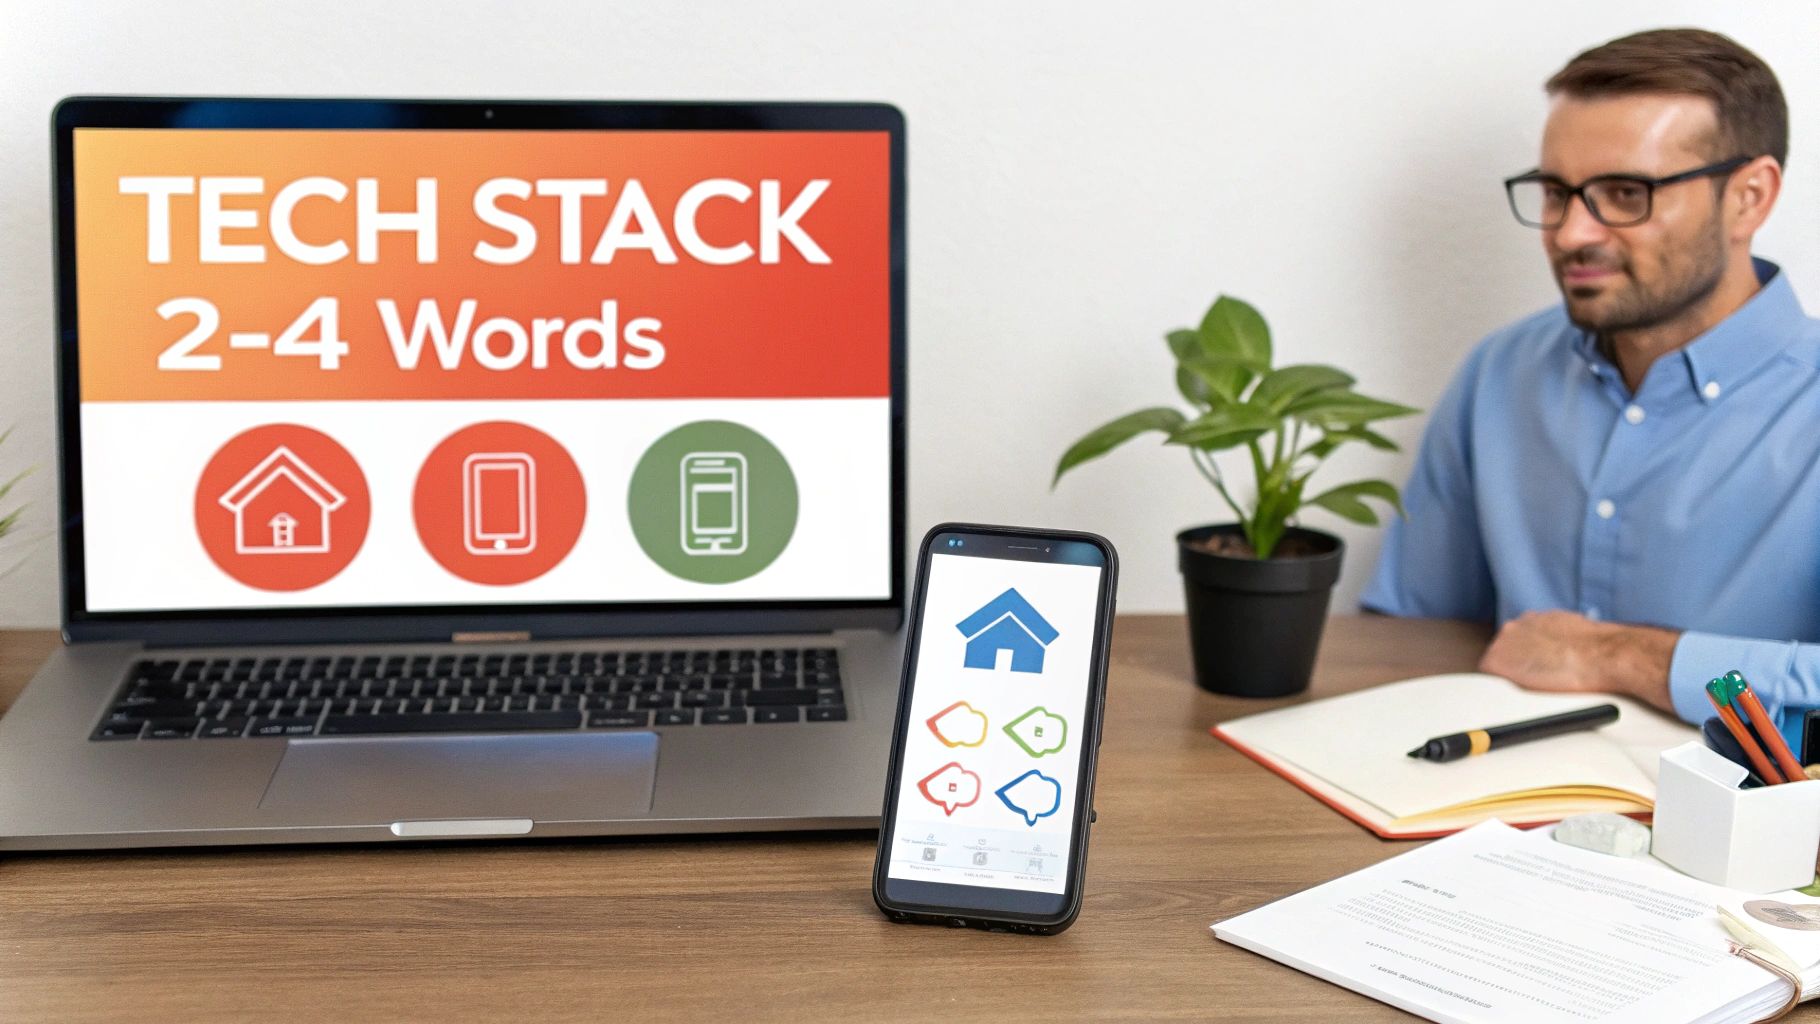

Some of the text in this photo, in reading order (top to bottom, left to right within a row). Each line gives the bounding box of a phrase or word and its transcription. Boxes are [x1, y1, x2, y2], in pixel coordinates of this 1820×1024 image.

[118, 175, 832, 265] TECH STACK
[156, 296, 667, 371] 2-4 Words
